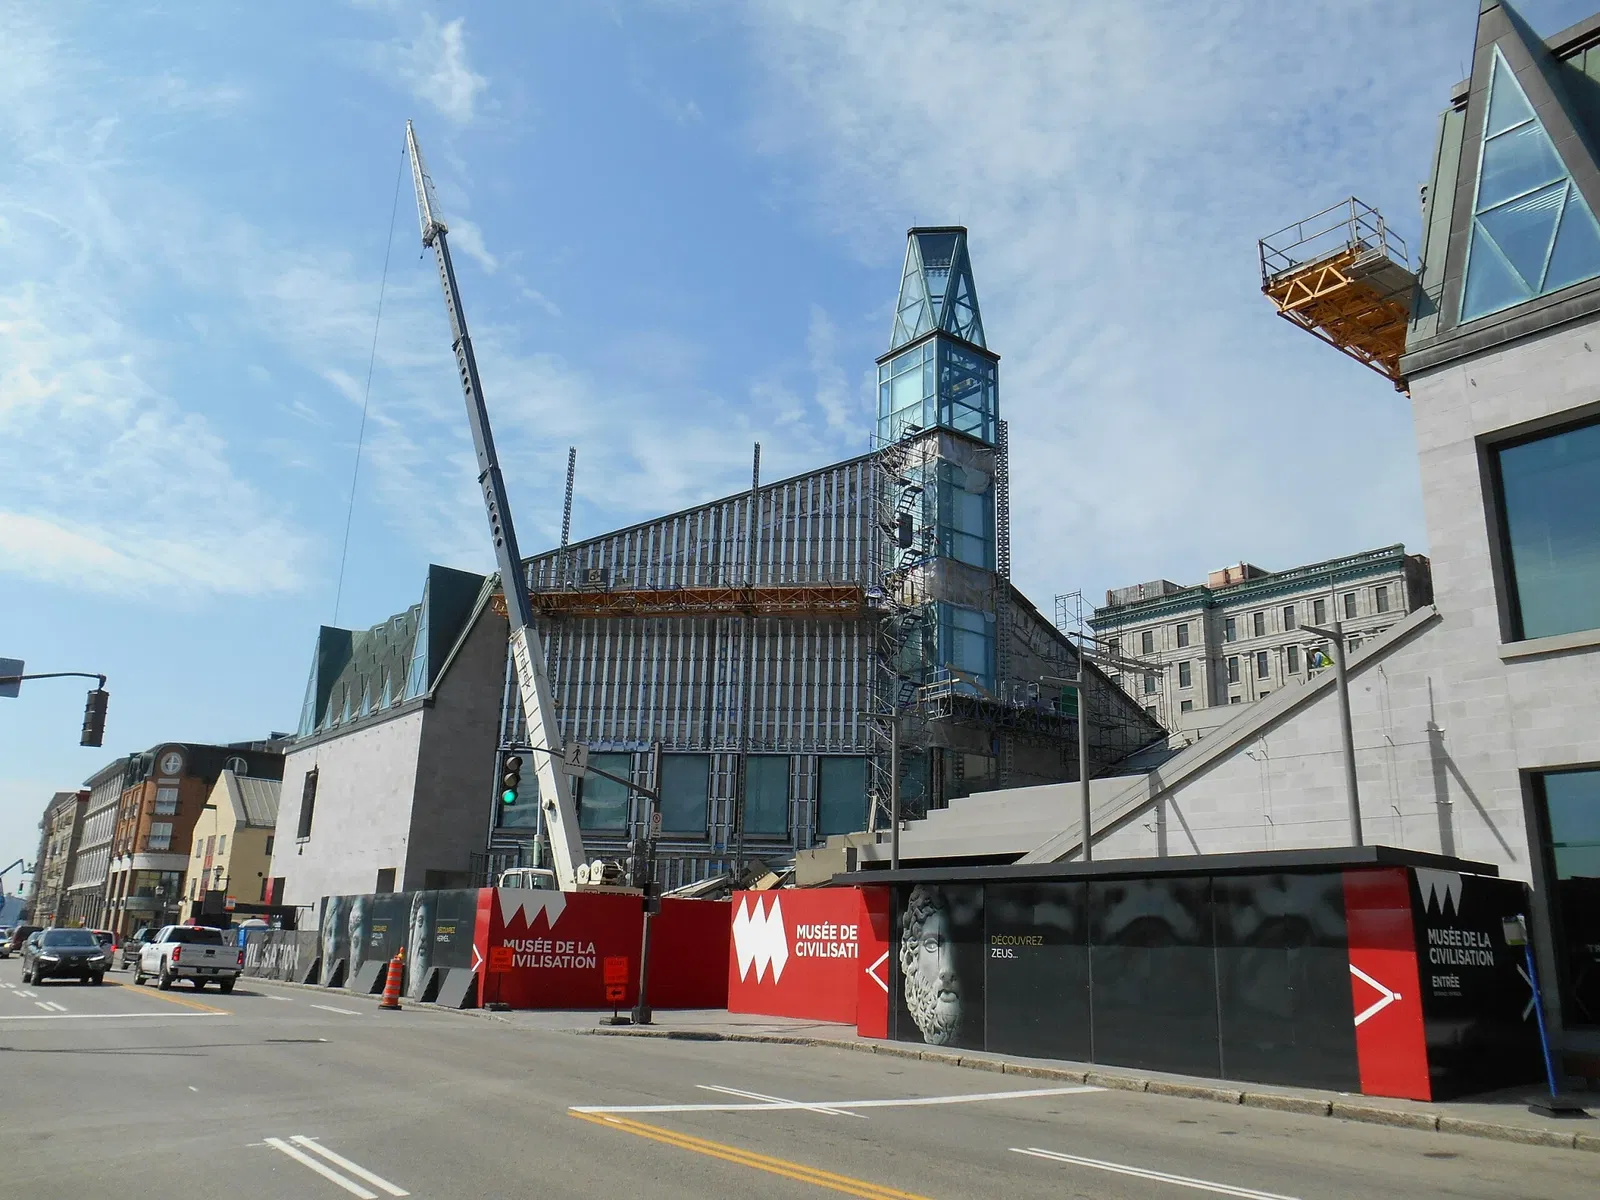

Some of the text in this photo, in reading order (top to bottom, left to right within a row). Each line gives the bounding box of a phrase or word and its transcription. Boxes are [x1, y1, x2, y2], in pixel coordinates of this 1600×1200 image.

[796, 920, 858, 940] MUSÉE DE
[1427, 925, 1492, 948] MUSÉE DE LA
[503, 937, 596, 955] MUSÉE DE LA
[991, 933, 1043, 946] DÉCOUVREZ
[795, 941, 859, 959] CIVILISATI
[1429, 947, 1495, 967] CIVILISATION
[511, 954, 596, 969] IVILISATION
[1431, 973, 1461, 988] ENTRÉE
